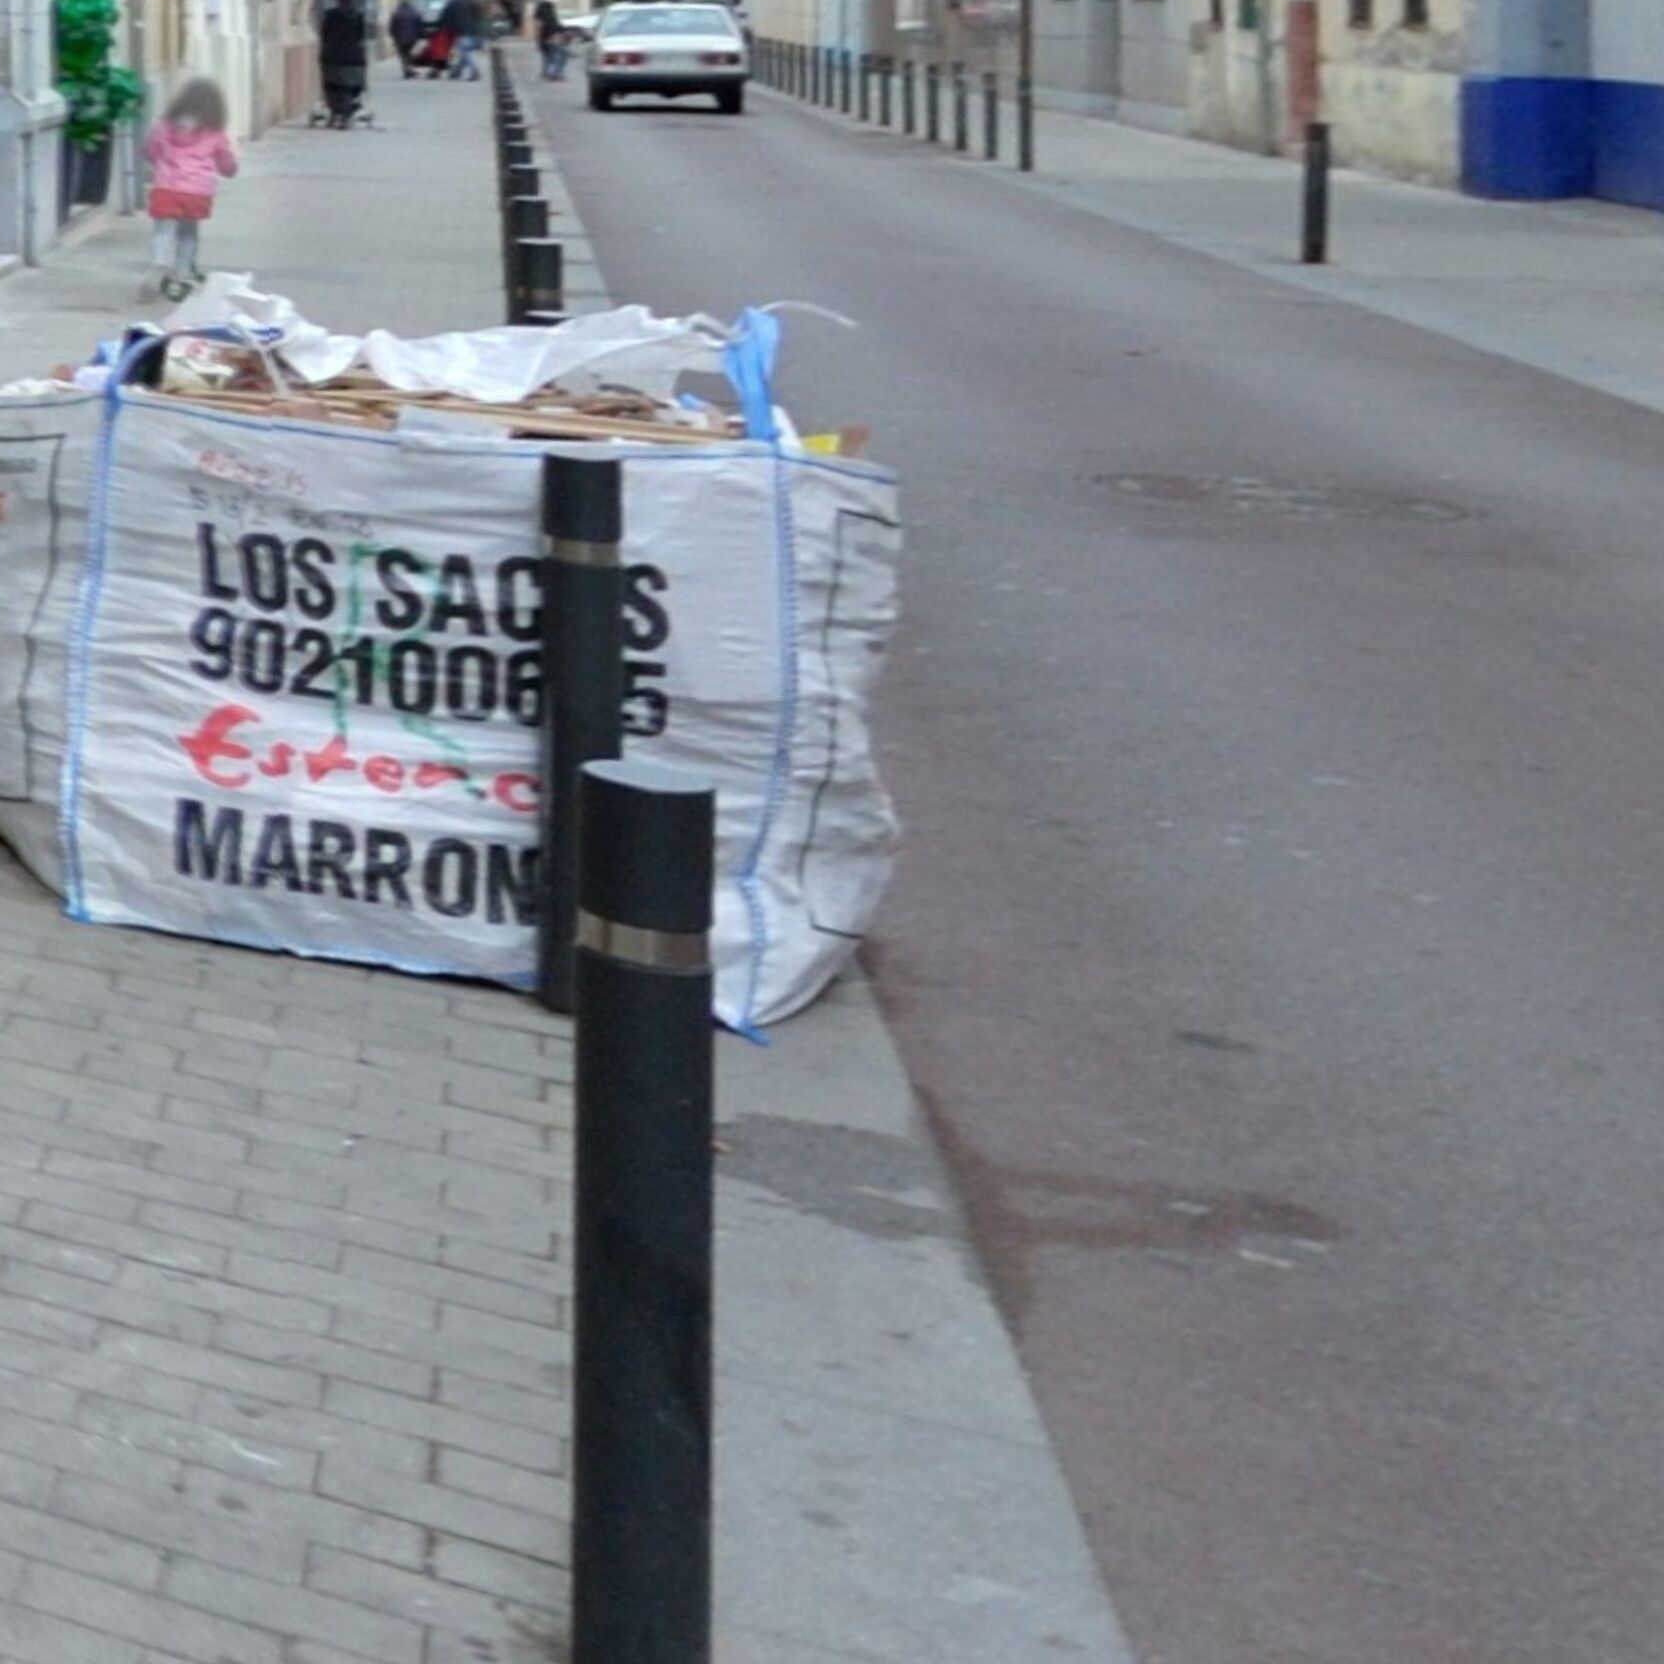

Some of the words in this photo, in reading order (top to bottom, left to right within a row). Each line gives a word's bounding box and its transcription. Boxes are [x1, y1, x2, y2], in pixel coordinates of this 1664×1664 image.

[196, 522, 337, 622] LOS
[374, 549, 670, 652] SACS
[190, 607, 670, 737] 90210065
